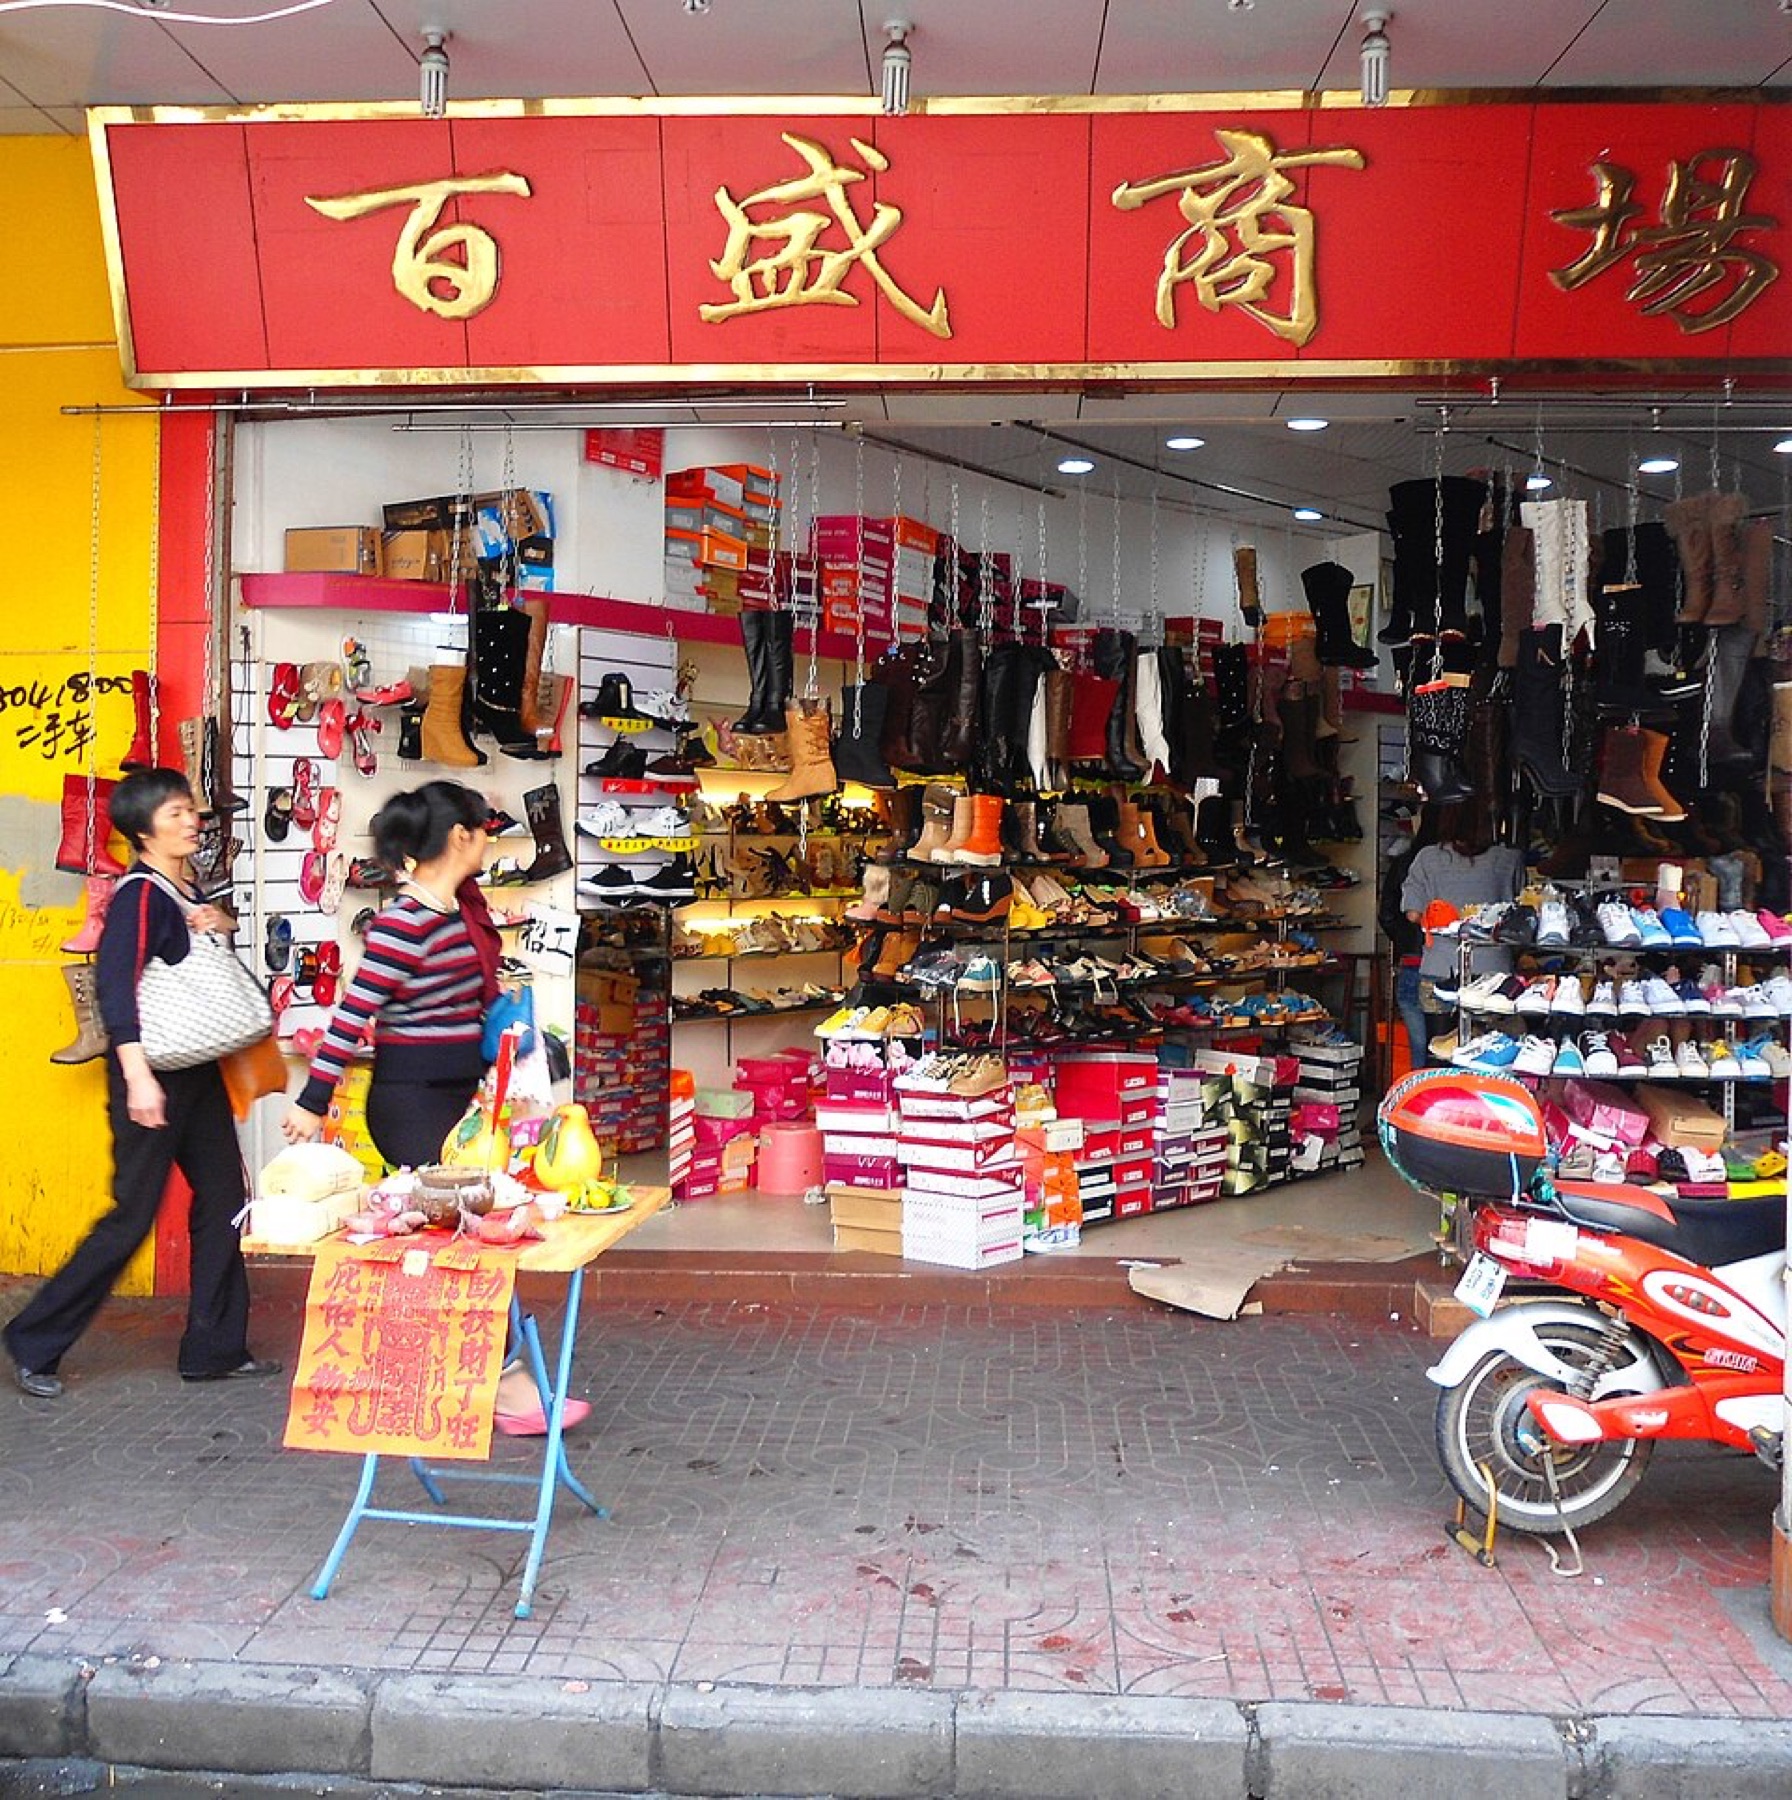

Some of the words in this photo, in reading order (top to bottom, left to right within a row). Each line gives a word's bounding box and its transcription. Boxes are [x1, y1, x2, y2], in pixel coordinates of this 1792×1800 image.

[304, 127, 1778, 347] 百盛商場
[16, 709, 97, 764] 二手车
[521, 919, 574, 958] 招工
